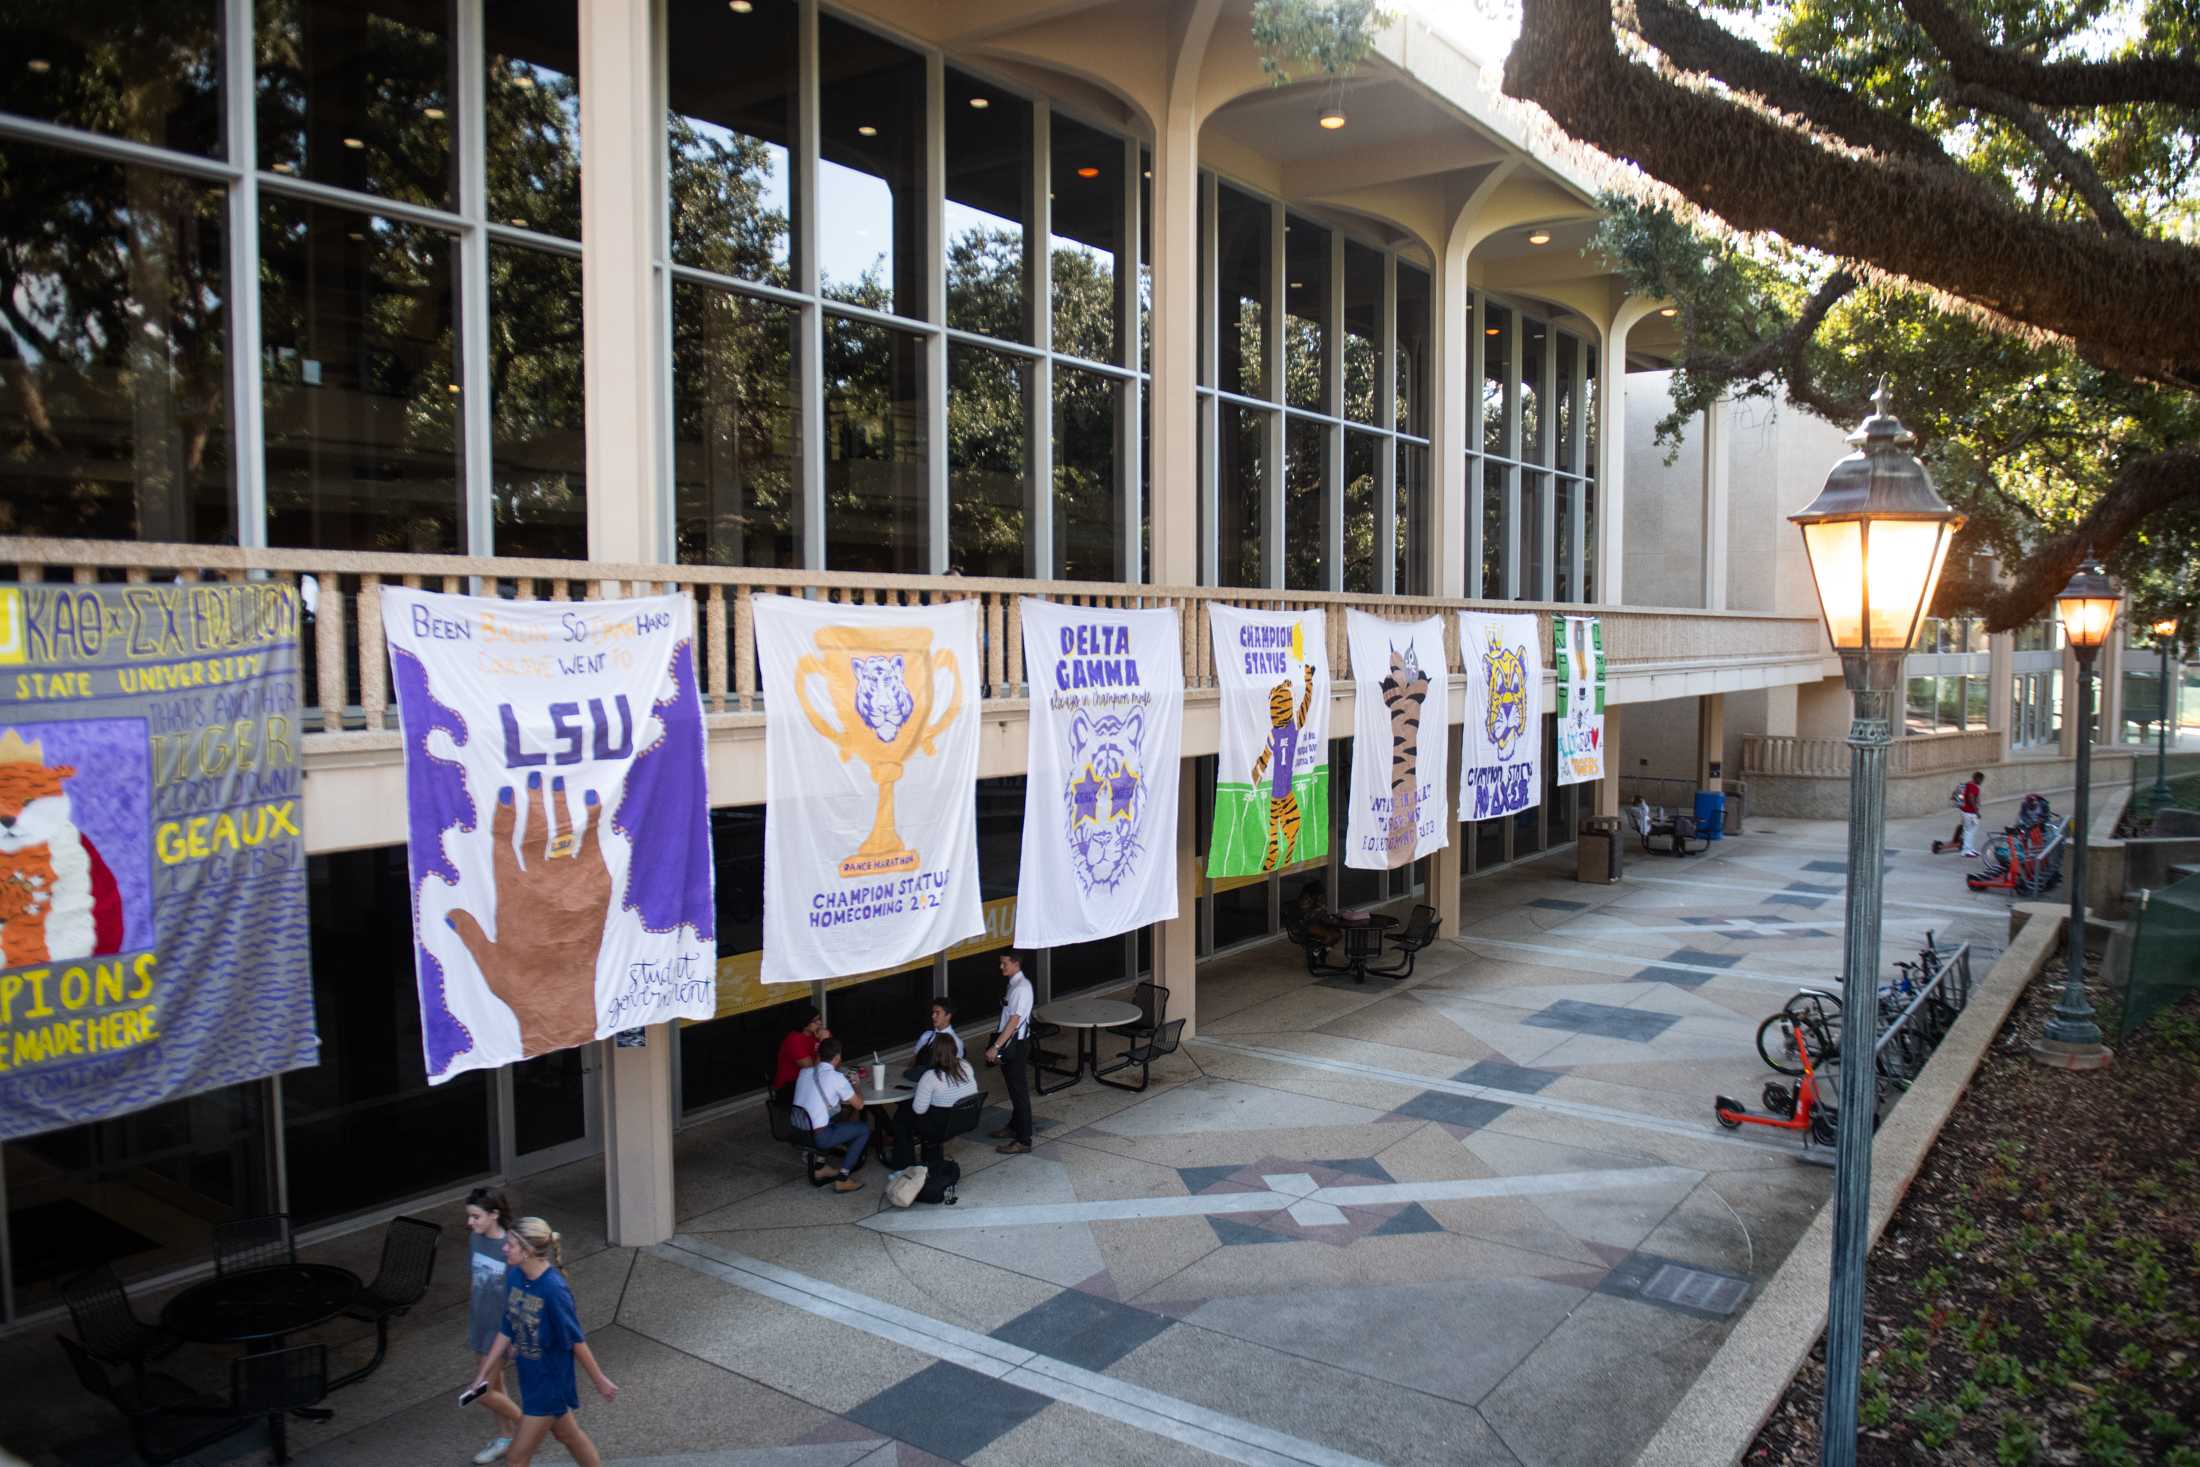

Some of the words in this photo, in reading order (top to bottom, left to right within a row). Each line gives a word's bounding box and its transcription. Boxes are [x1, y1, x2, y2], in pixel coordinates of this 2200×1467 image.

[411, 604, 471, 640] BEEN
[636, 611, 670, 635] HARD
[1239, 625, 1293, 648] CHAMPION
[1060, 624, 1130, 656] DELTA
[16, 671, 93, 699] STATE
[117, 654, 261, 694] UNIVERSITY
[558, 652, 606, 676] WENT
[1055, 659, 1140, 691] GAMMA
[1244, 652, 1287, 675] STATUS
[498, 694, 634, 768] LSU
[151, 714, 293, 786] TIGER
[156, 801, 300, 865] GEAUX
[812, 882, 895, 909] CHAMPION
[809, 900, 904, 928] HOMECOMING
[0, 953, 158, 1024] PIONS
[14, 1019, 85, 1067] MADE
[87, 1004, 160, 1053] HERE
